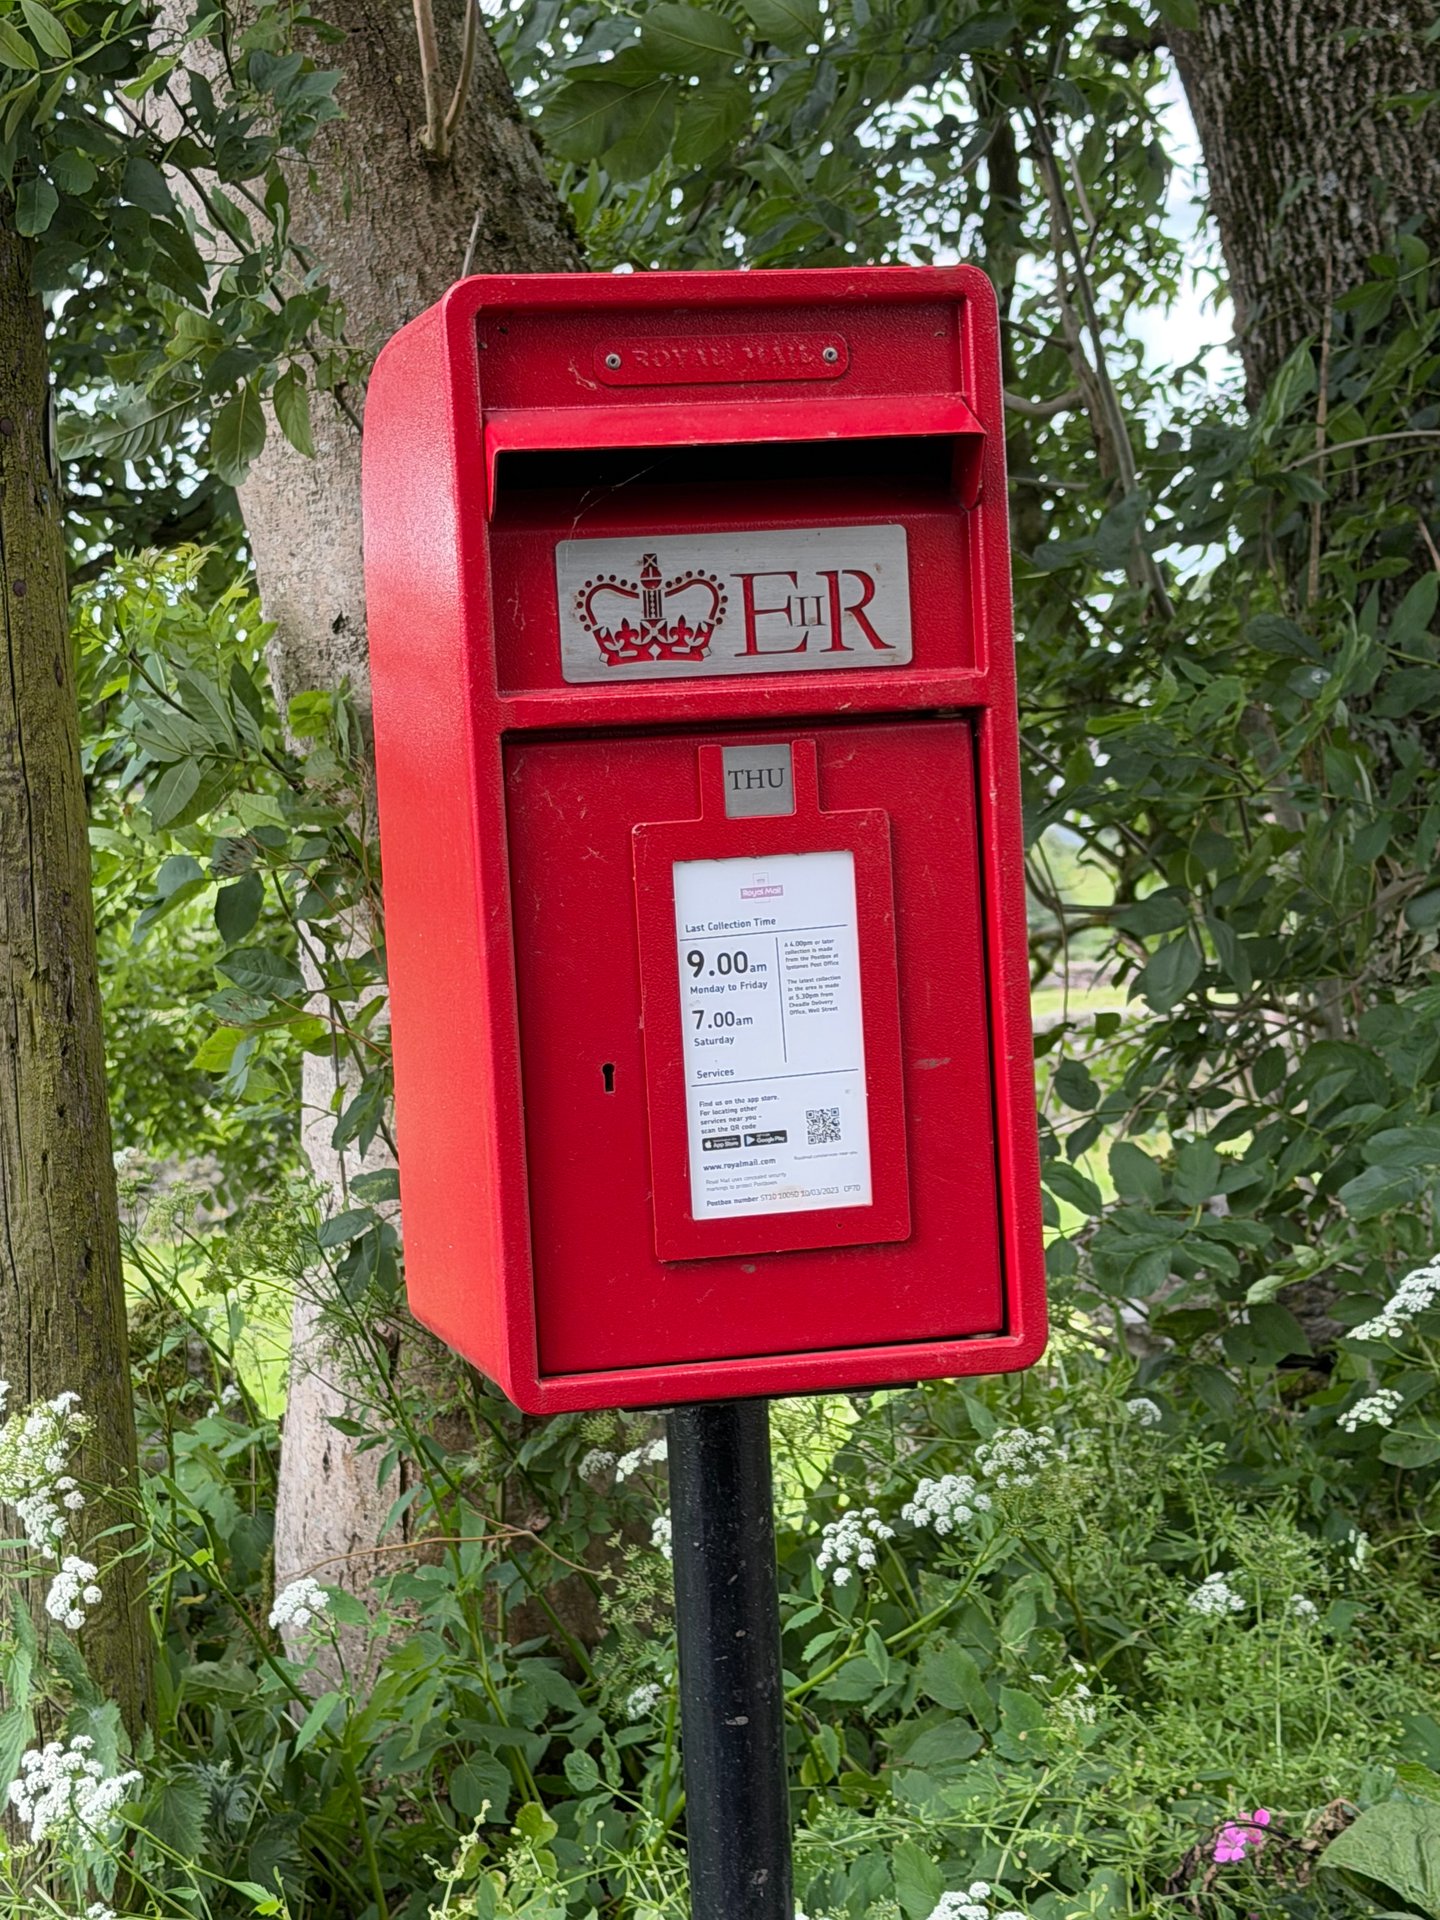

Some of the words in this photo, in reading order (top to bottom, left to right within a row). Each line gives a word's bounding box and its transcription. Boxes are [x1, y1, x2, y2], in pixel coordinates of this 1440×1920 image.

[728, 768, 785, 790] THU
[742, 888, 764, 897] Royal
[765, 886, 782, 895] Mail
[685, 924, 705, 933] Last
[707, 920, 751, 931] Collection
[753, 917, 776, 926] Time
[790, 939, 813, 947] 4.00pm
[785, 948, 810, 956] collection
[823, 959, 839, 967] Office
[690, 984, 725, 995] Monday
[728, 983, 737, 991] to
[740, 980, 768, 990] Friday
[795, 991, 819, 1000] 5.30pm
[694, 1036, 735, 1047] Saturday
[696, 1068, 735, 1079] Services
[699, 1100, 713, 1108] Find
[747, 1096, 759, 1104] app
[700, 1109, 711, 1117] For
[712, 1107, 738, 1115] locating
[740, 1105, 758, 1113] other
[700, 1117, 727, 1126] services
[728, 1115, 743, 1123] near
[745, 1114, 757, 1123] you
[717, 1125, 729, 1133] the
[730, 1124, 740, 1132] QR
[741, 1123, 757, 1131] code
[724, 1139, 739, 1147] Store
[756, 1136, 774, 1144] Google
[774, 1134, 785, 1142] Play
[703, 1158, 776, 1171] www.royalmail.com
[706, 1199, 732, 1207] Postbox
[733, 1196, 759, 1204] number
